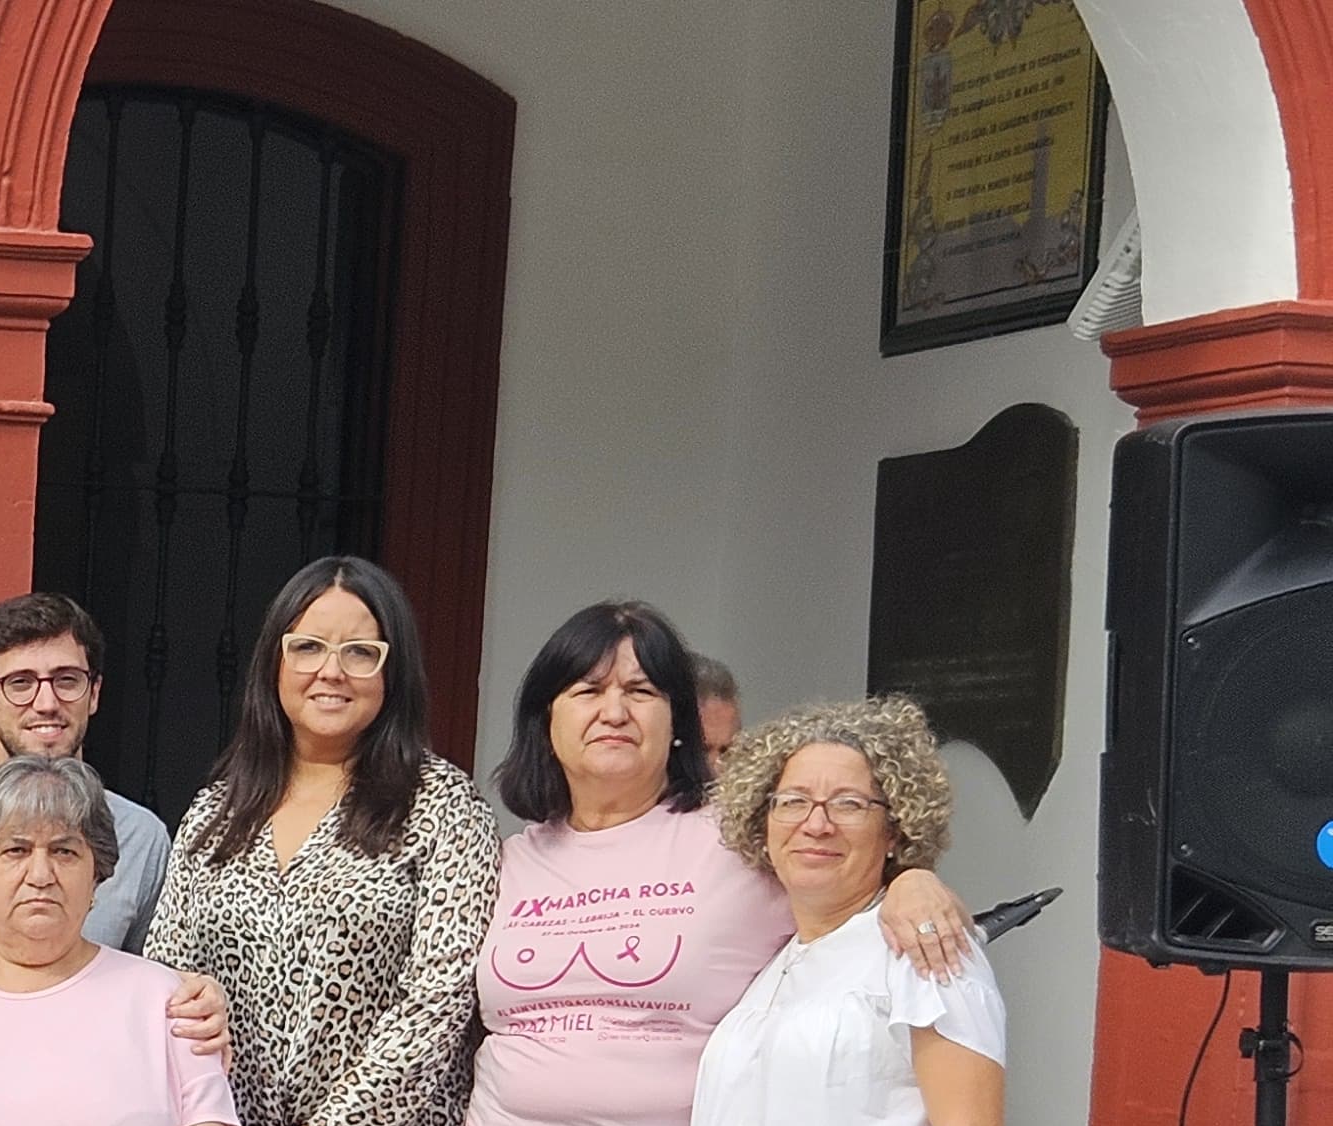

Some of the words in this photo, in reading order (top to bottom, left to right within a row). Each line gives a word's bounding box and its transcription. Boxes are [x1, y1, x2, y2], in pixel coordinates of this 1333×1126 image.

[510, 895, 551, 918] IX
[545, 886, 631, 912] MARCHA
[638, 881, 695, 899] ROSA
[632, 909, 645, 917] EL
[649, 906, 695, 917] CUERVO
